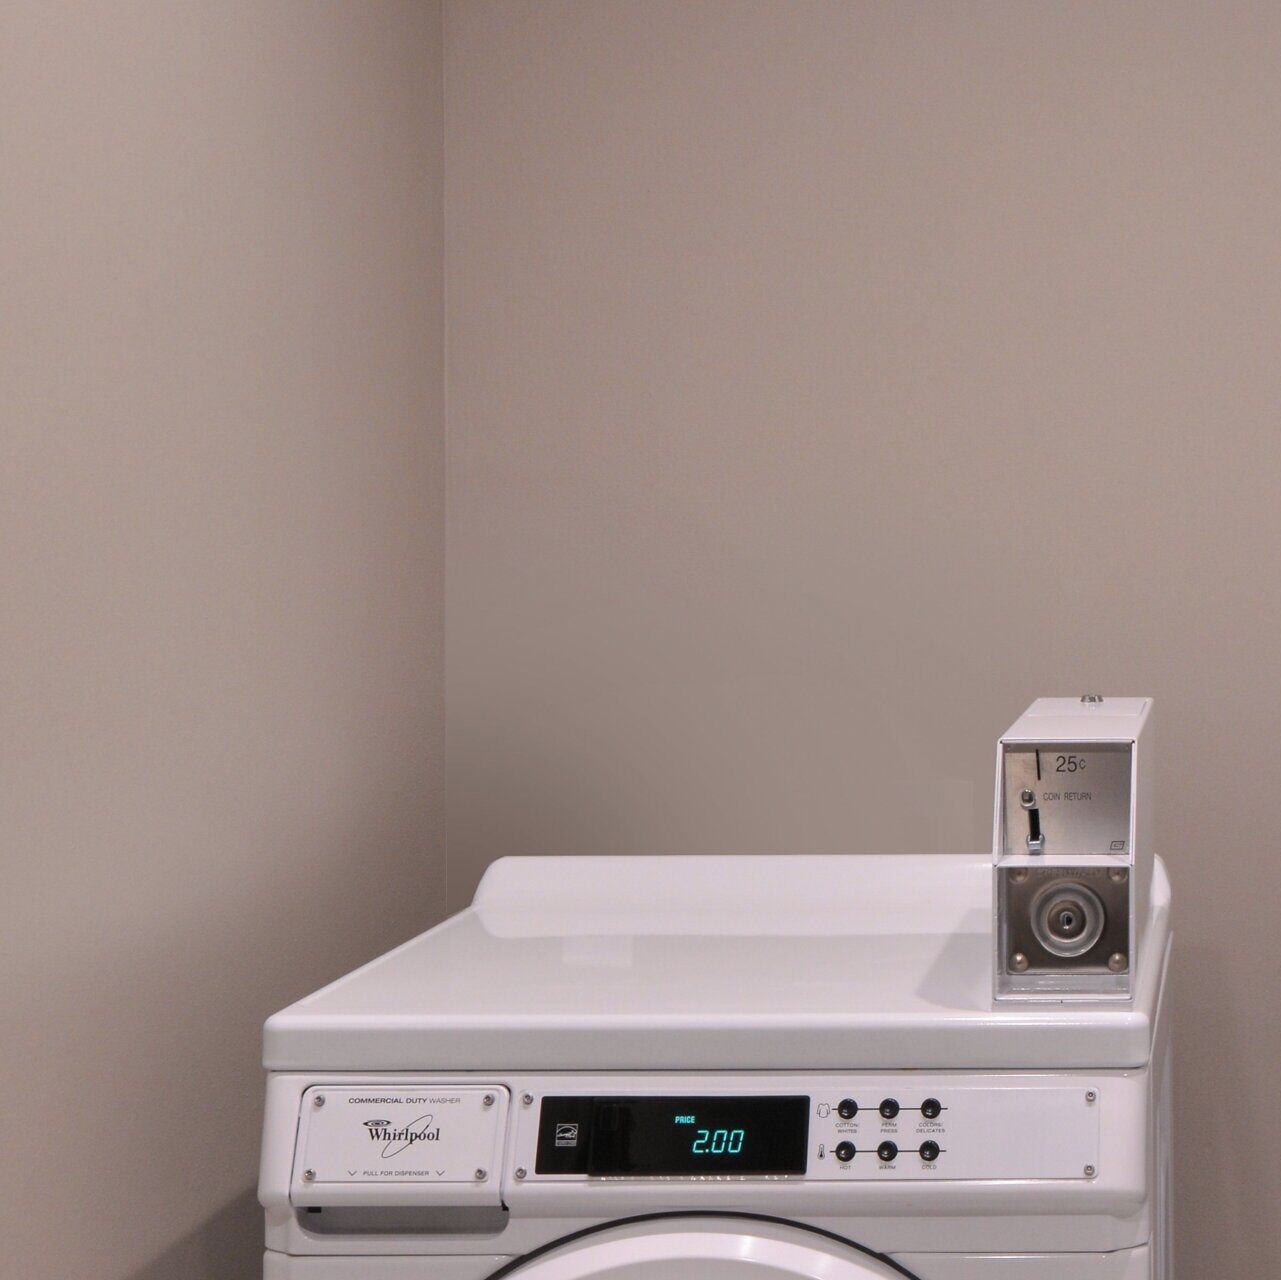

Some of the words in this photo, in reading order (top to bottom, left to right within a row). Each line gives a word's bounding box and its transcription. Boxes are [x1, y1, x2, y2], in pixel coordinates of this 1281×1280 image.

[1043, 792, 1061, 801] COIN
[1063, 792, 1092, 801] RETURN
[675, 1115, 696, 1124] PRICE
[368, 1128, 440, 1145] Whirlpool
[692, 1129, 745, 1154] 2.00
